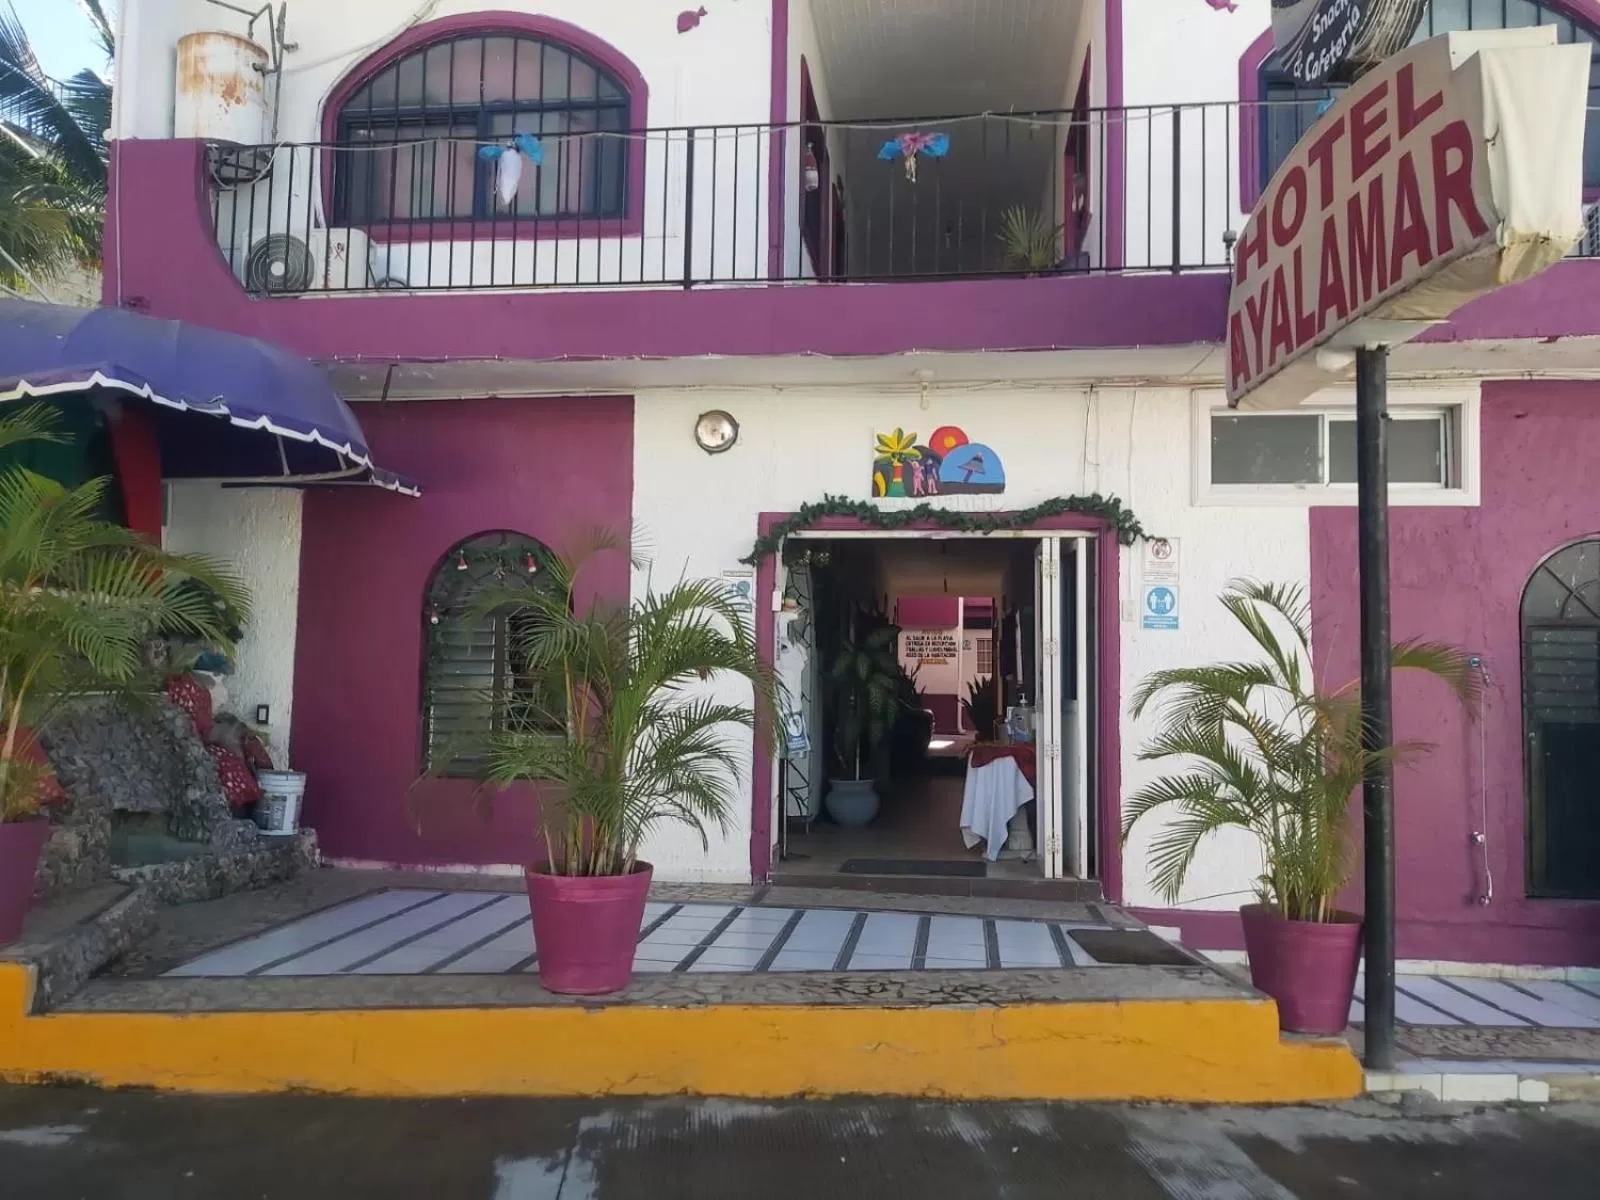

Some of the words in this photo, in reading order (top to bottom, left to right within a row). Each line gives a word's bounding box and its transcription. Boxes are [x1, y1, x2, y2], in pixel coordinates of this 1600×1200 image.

[1236, 62, 1443, 285] HOTEL
[1293, 48, 1304, 79] &
[1230, 119, 1489, 391] AYALAMAR
